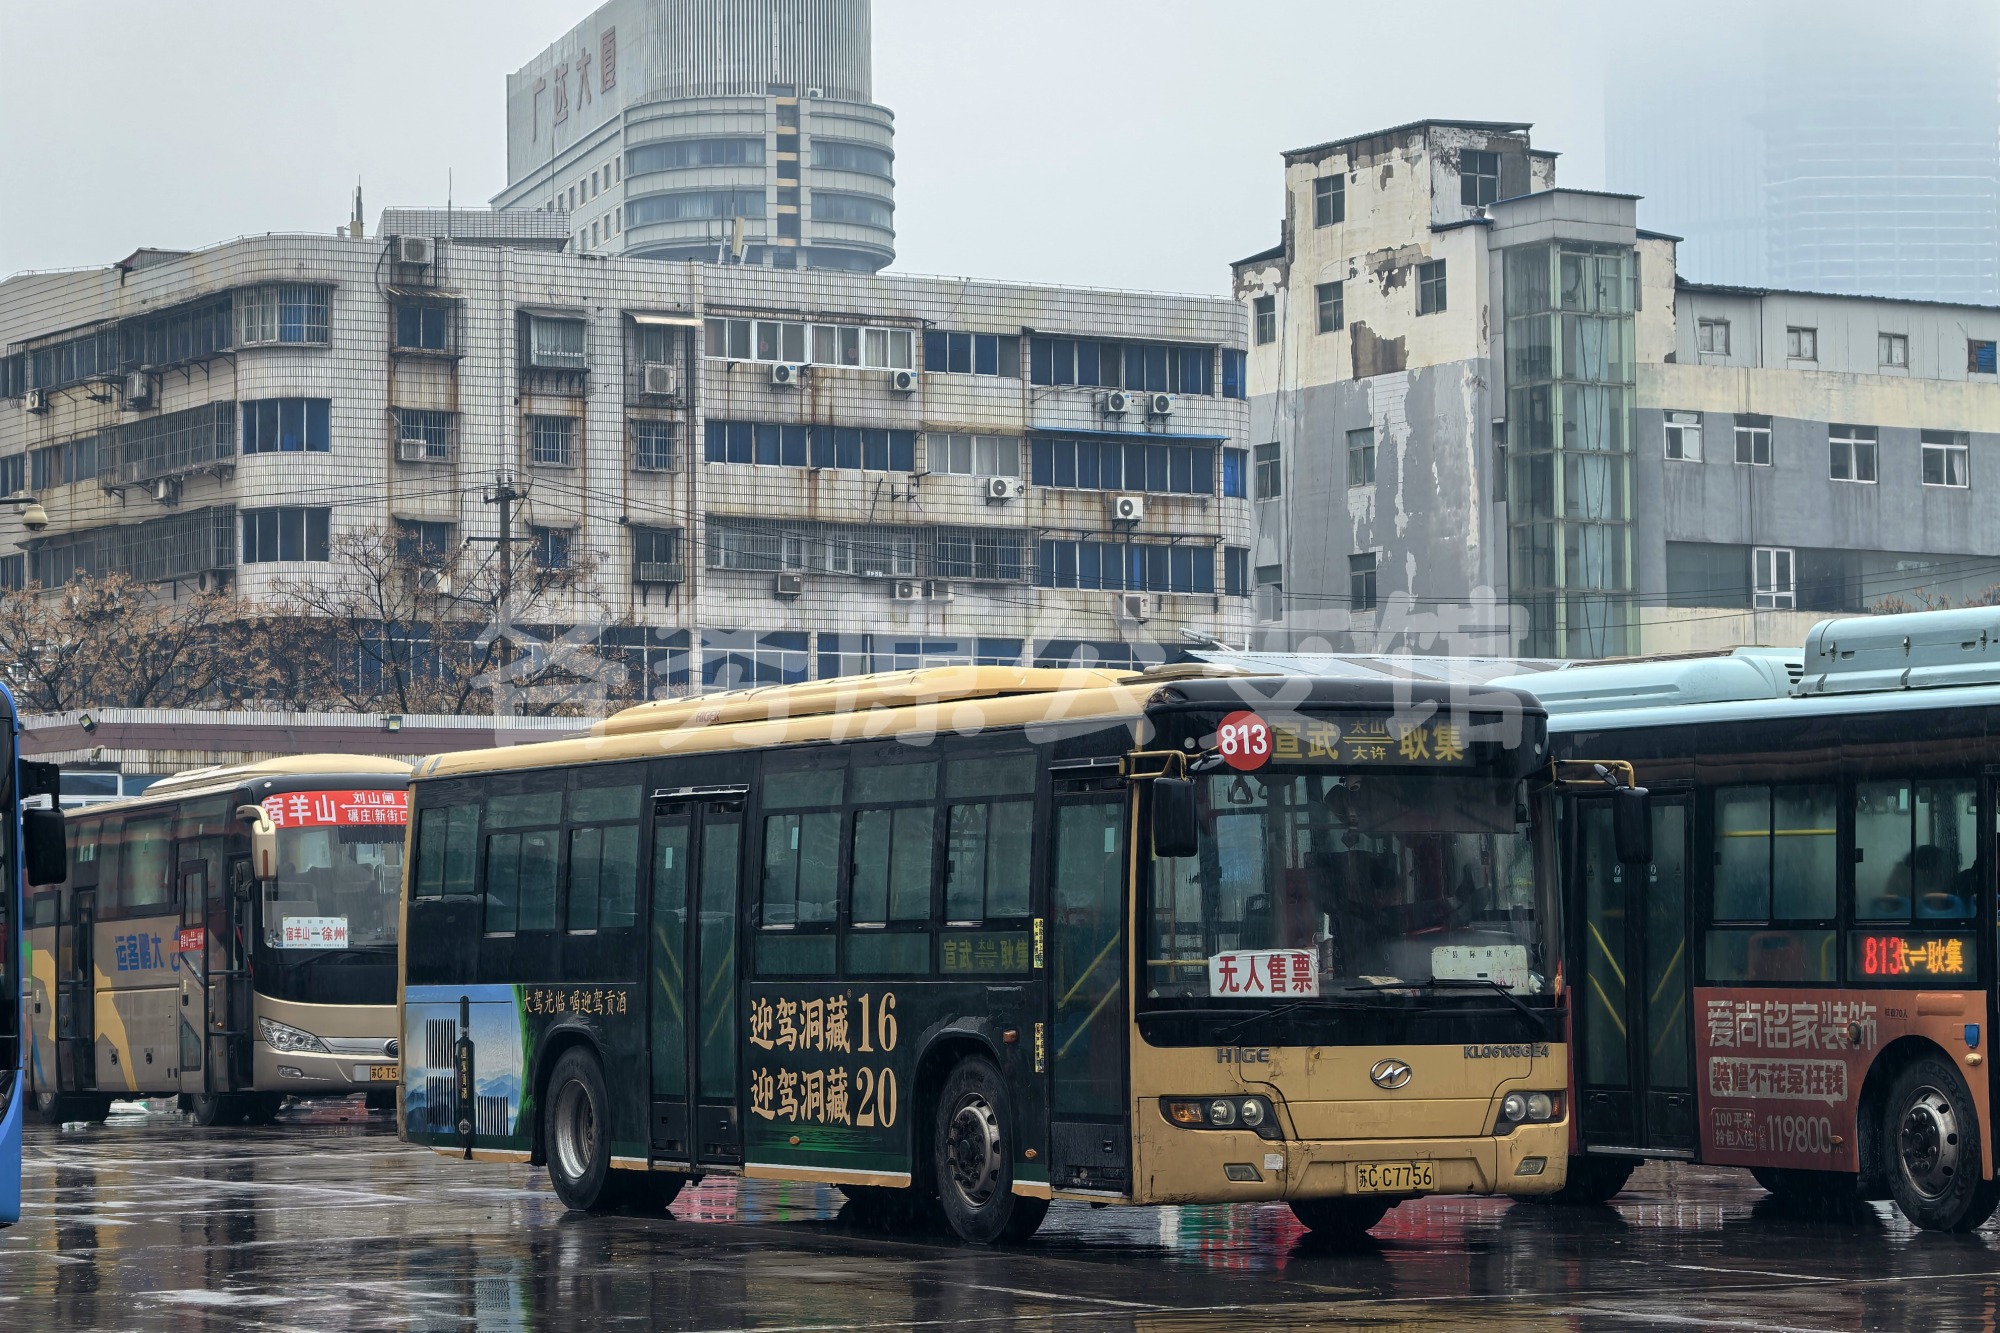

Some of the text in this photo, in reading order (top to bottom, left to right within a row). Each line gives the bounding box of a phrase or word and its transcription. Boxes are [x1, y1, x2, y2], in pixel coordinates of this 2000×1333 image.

[531, 26, 617, 143] 广达大厦
[1220, 723, 1269, 755] 813
[1272, 720, 1339, 761] 宣武
[1350, 719, 1386, 735] 太山
[1399, 722, 1465, 761] 耿集
[1352, 746, 1387, 761] 大许
[262, 794, 337, 825] 宿羊山
[352, 791, 395, 805] 刘山闸
[943, 939, 973, 970] 宣武
[1864, 936, 1902, 975] 813
[1926, 938, 1963, 974] 耿集
[1218, 953, 1313, 994] 无人售票
[523, 988, 627, 1016] 大驾光临 喝迎驾贡酒
[749, 992, 898, 1054] 迎驾洞藏 16
[1707, 1000, 1878, 1051] 爱尚铭家装饰
[1217, 1047, 1269, 1064] HIGE
[1712, 1061, 1845, 1096] 装修不花冤枉钱
[750, 1065, 898, 1128] 迎驾洞藏 20
[1715, 1129, 1755, 1147] 拎包入住
[1766, 1115, 1832, 1154] 119800
